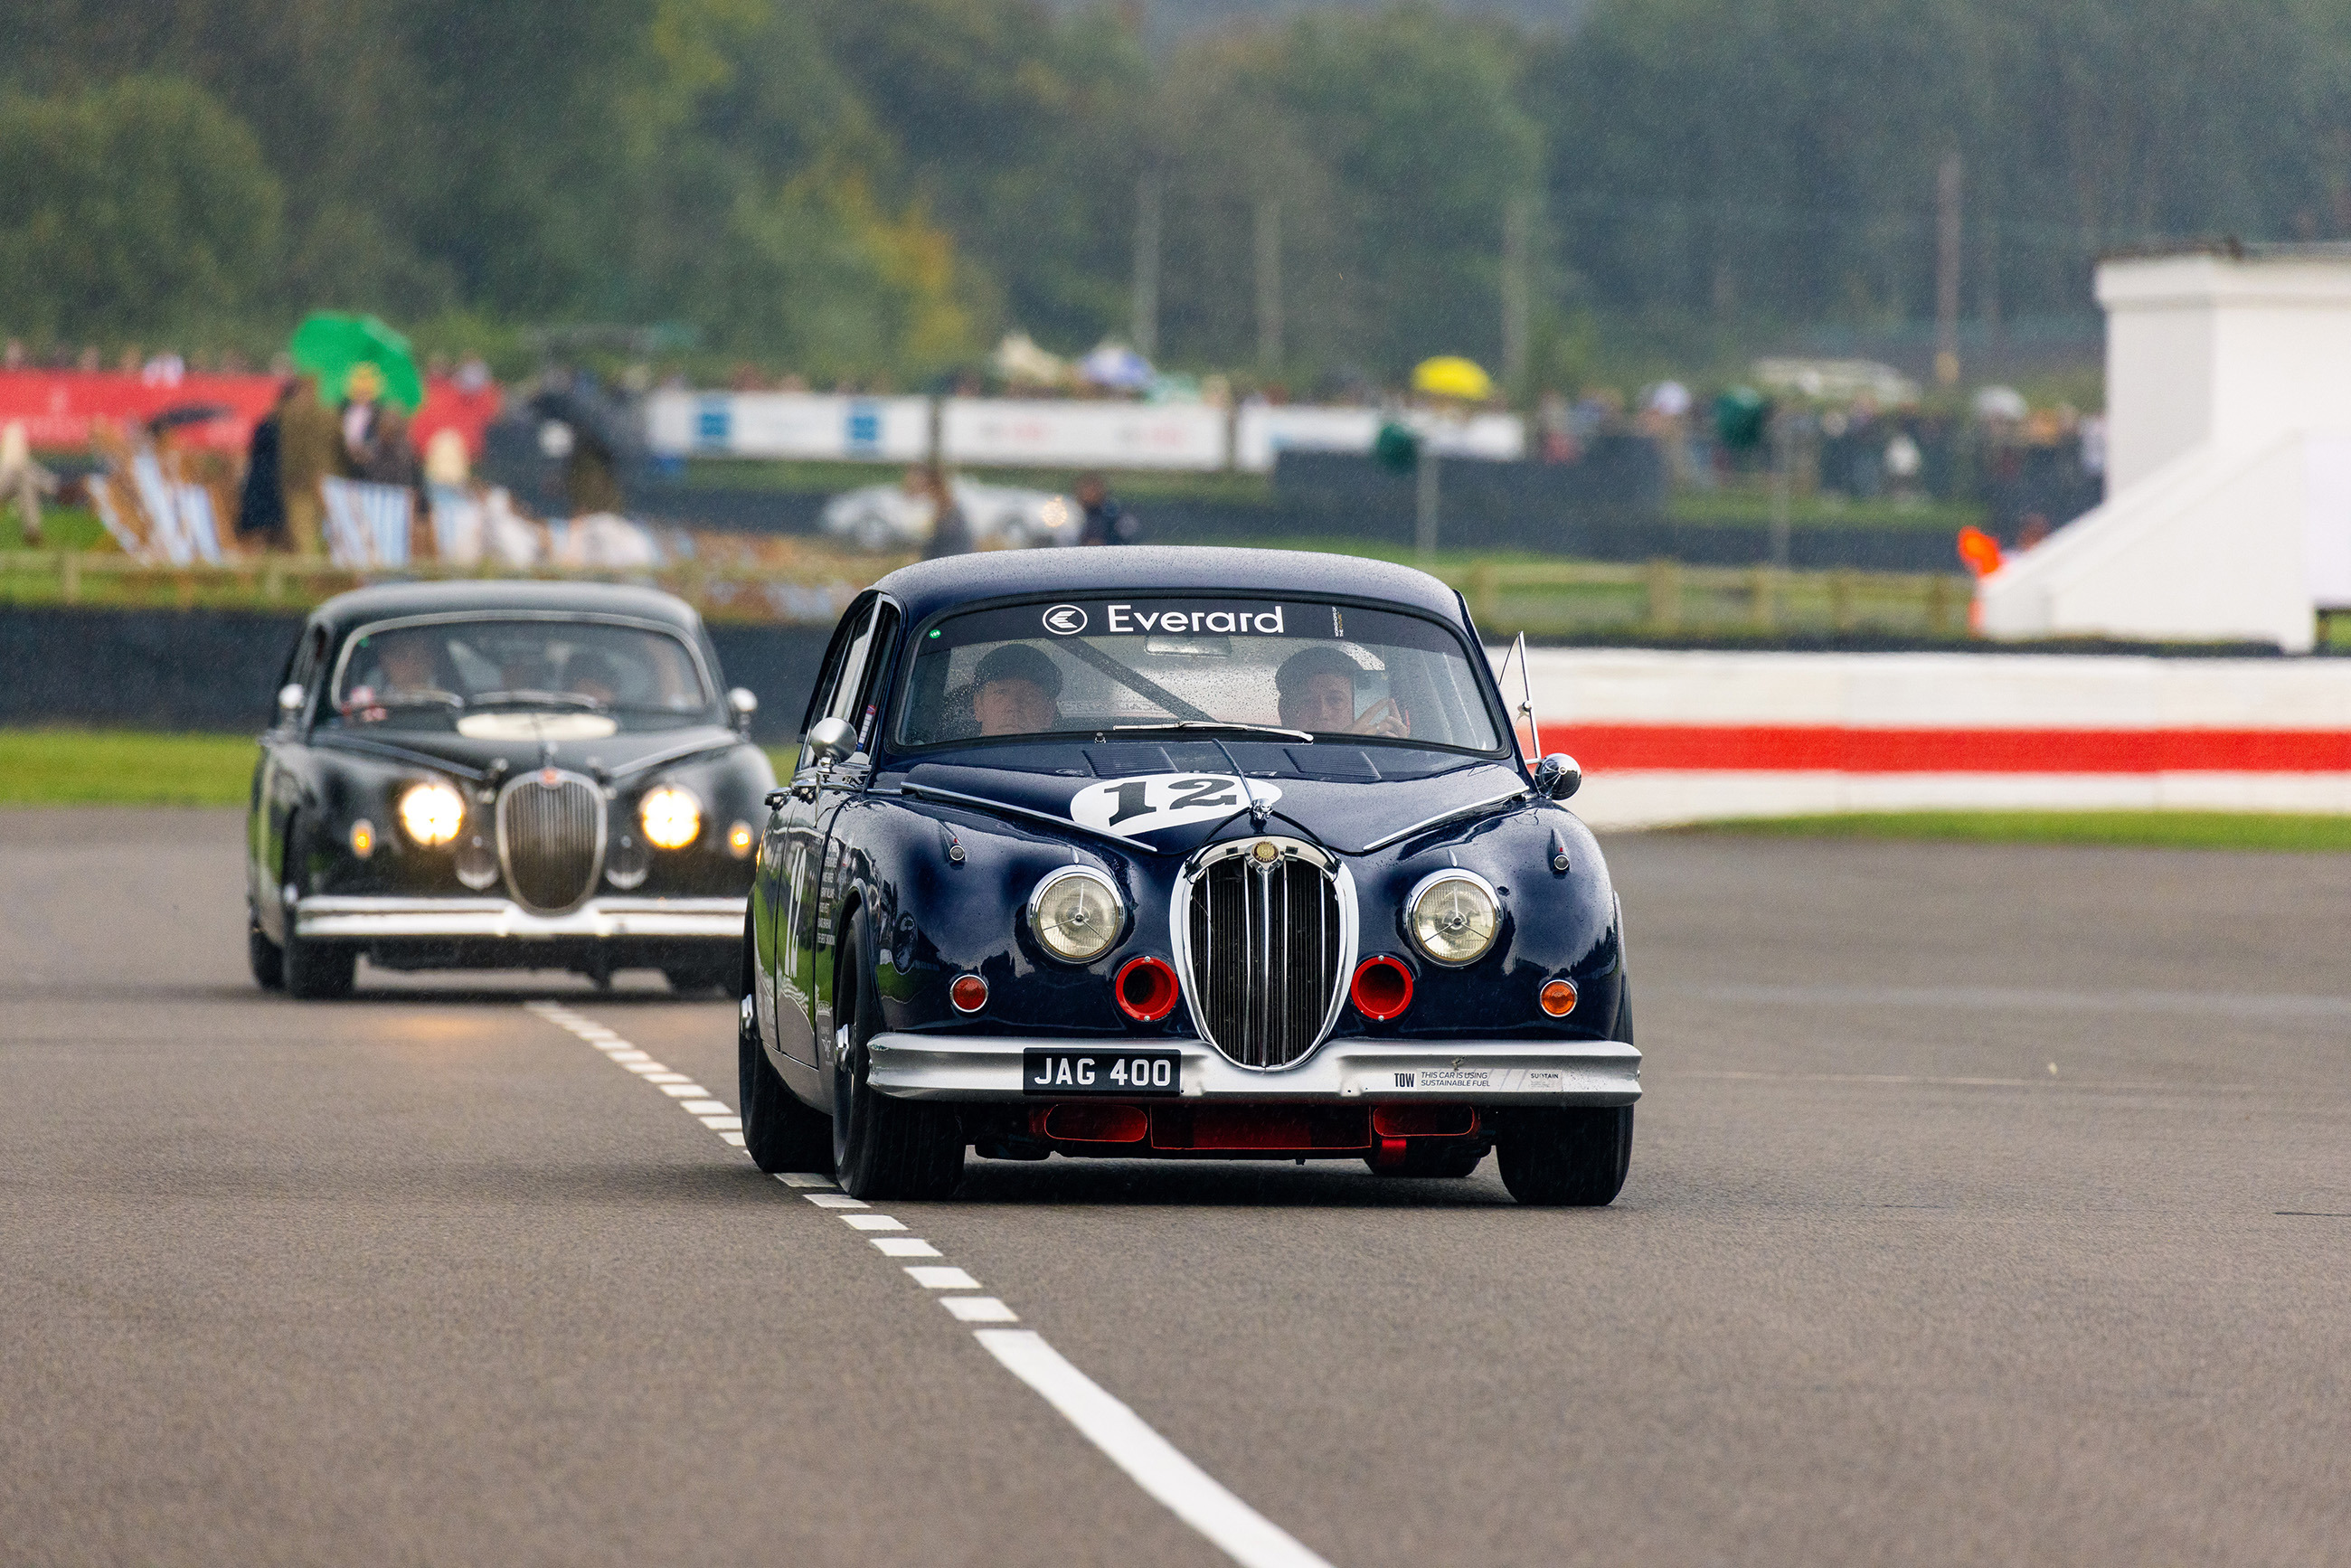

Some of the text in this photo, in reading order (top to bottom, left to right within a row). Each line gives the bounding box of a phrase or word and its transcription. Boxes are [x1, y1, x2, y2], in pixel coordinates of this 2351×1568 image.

[1108, 605, 1284, 633] Everard
[1104, 779, 1237, 827] 12
[784, 847, 807, 979] 12
[1034, 1058, 1171, 1087] JAG 400
[1394, 1072, 1414, 1087] TOW
[1465, 1072, 1487, 1080] USING
